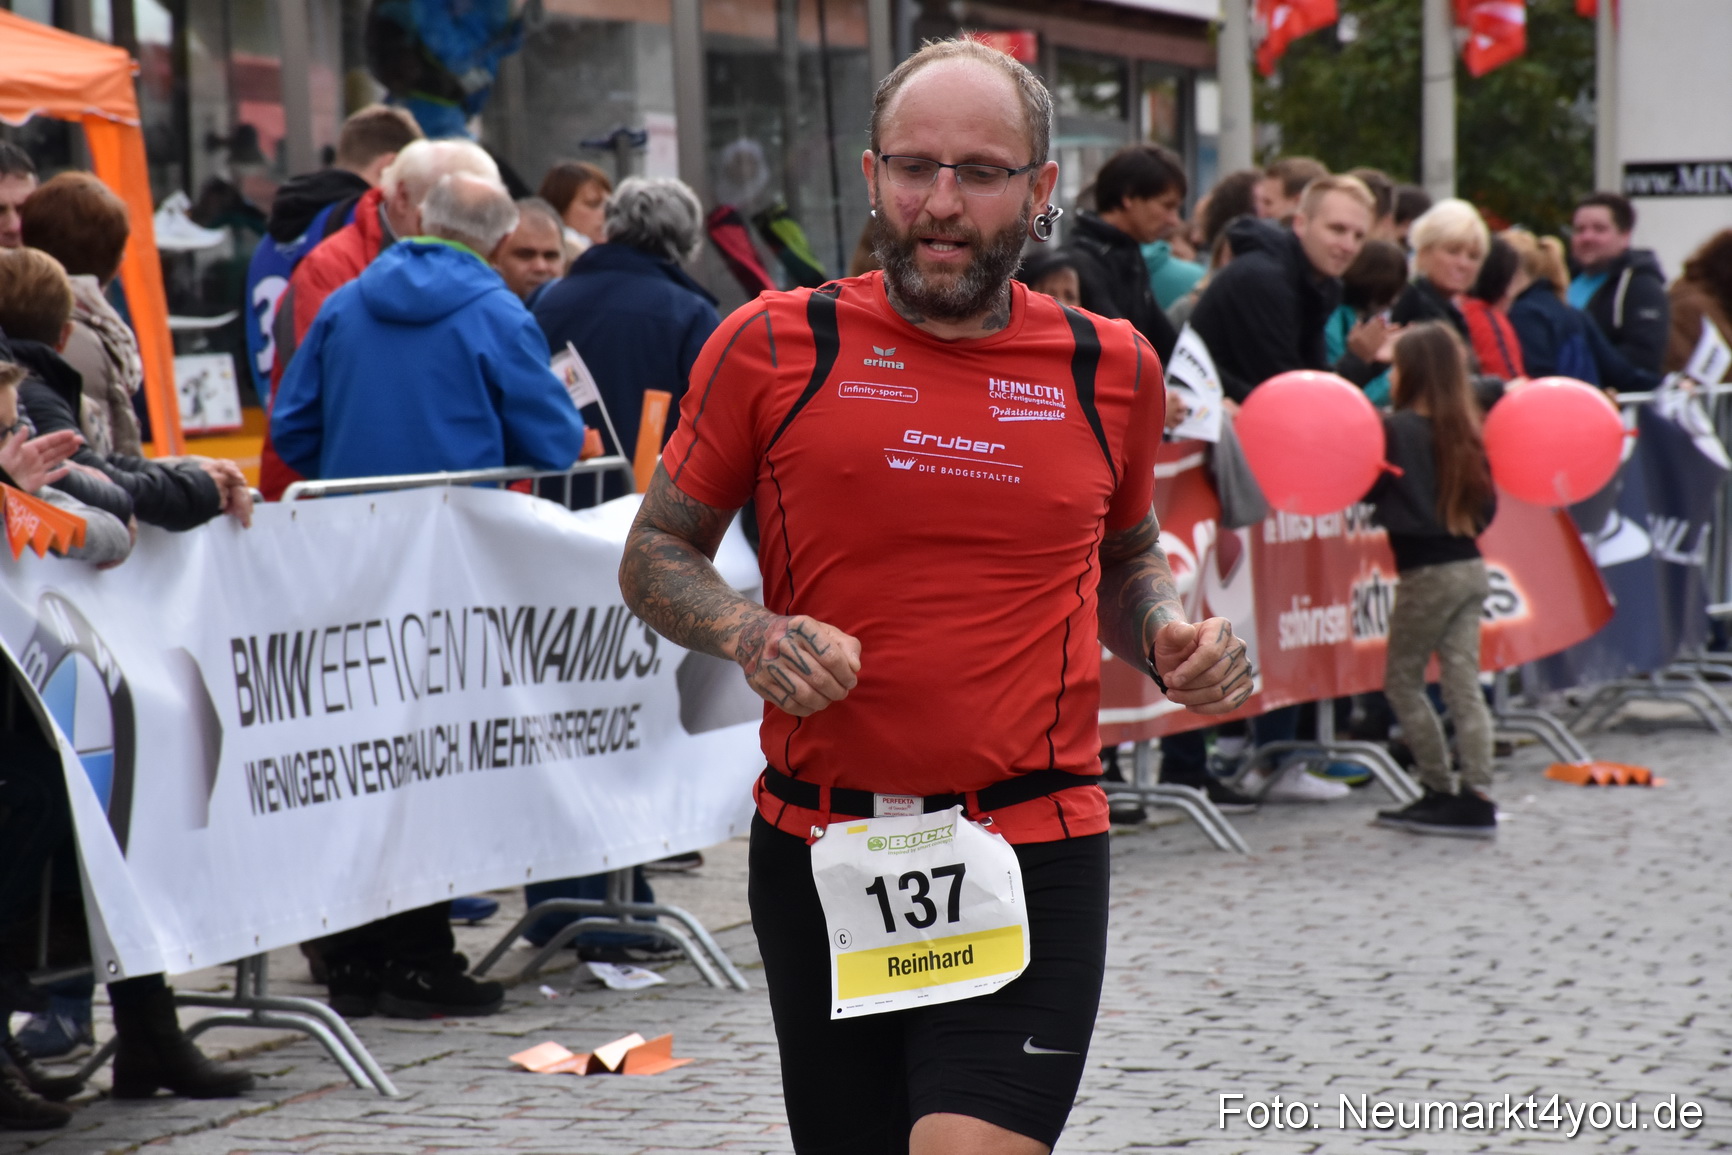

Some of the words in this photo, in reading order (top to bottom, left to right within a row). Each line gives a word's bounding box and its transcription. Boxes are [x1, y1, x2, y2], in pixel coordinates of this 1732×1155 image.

[863, 357, 905, 370] erima
[988, 377, 1065, 401] HEINLOTH
[902, 429, 1006, 454] Gruber
[918, 463, 936, 474] DIE
[940, 466, 1021, 484] BADGESTALTER
[230, 629, 318, 728] BMW
[244, 747, 342, 817] WENIGER
[882, 797, 915, 805] PERFEKTA
[889, 824, 954, 850] BOCK
[865, 863, 966, 933] 137
[888, 944, 974, 977] Reinhard
